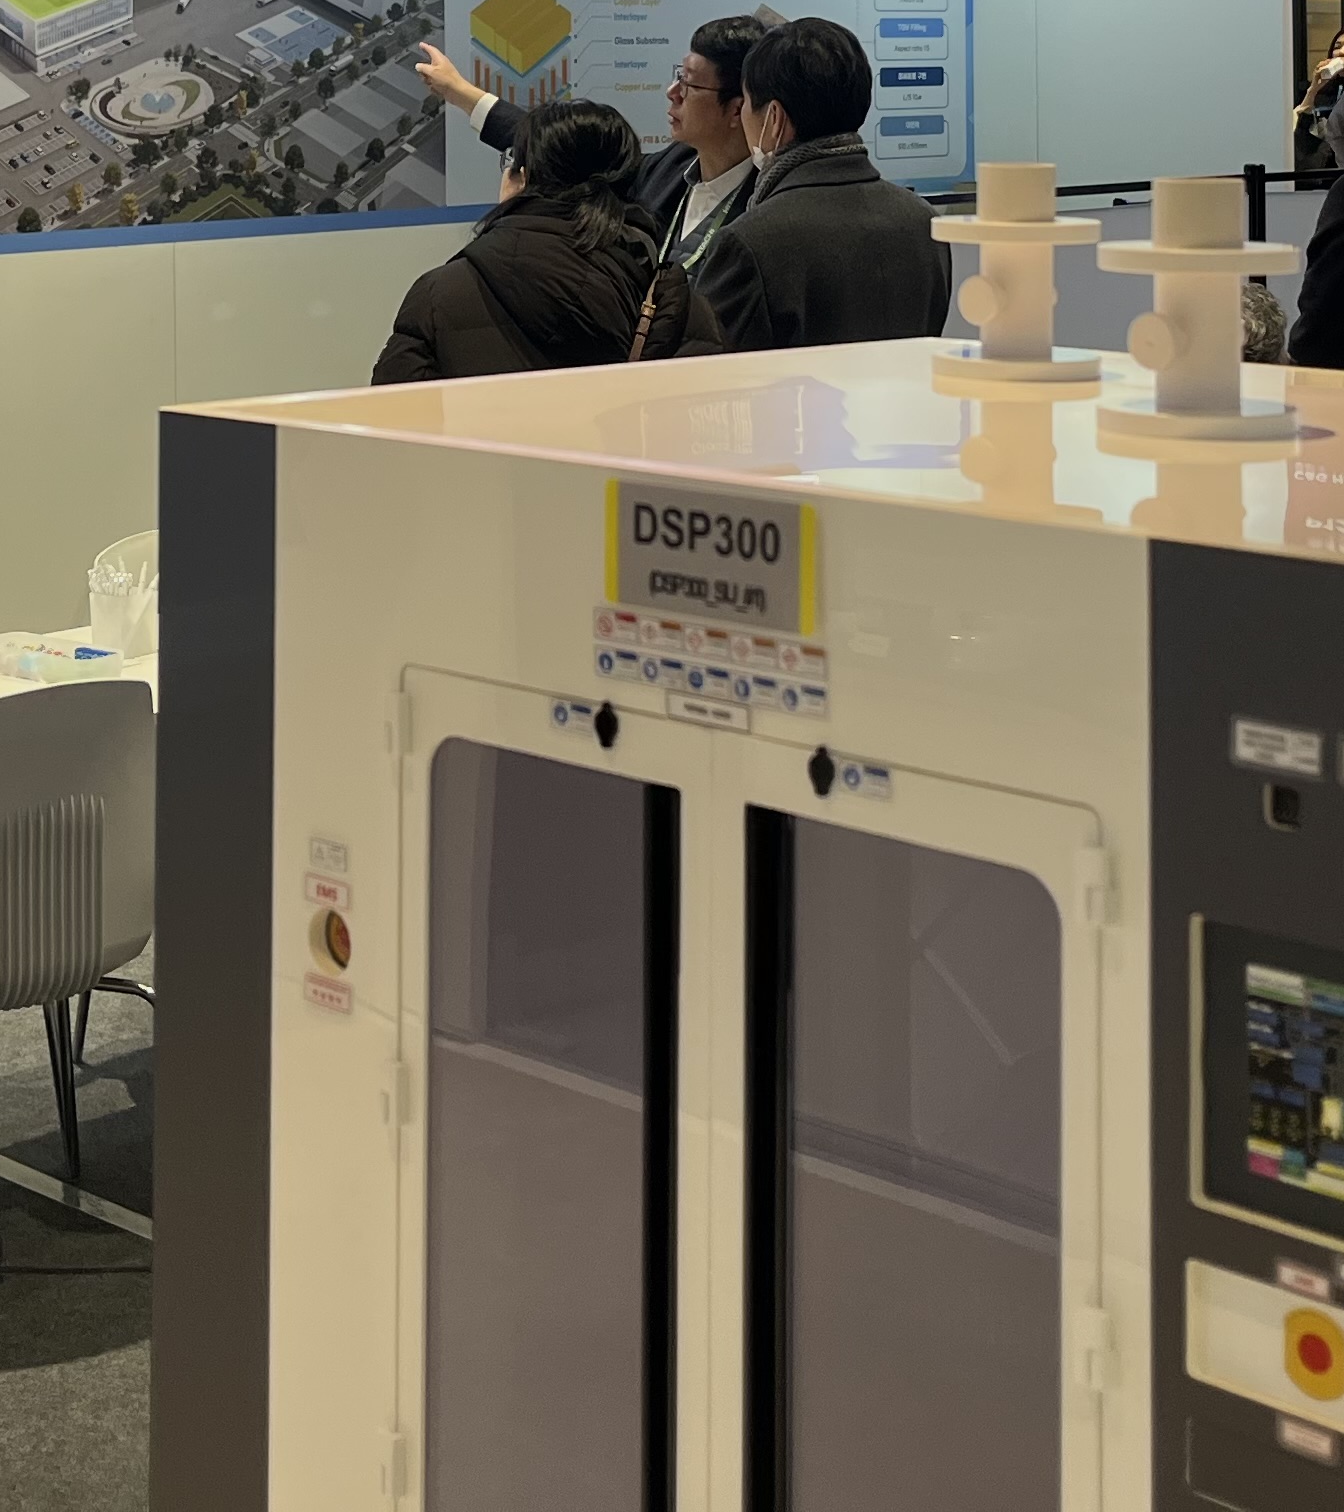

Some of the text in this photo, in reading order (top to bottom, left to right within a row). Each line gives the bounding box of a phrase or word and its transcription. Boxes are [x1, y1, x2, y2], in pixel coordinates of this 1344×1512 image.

[614, 36, 670, 46] Glass Substrate
[633, 501, 781, 565] DSP300
